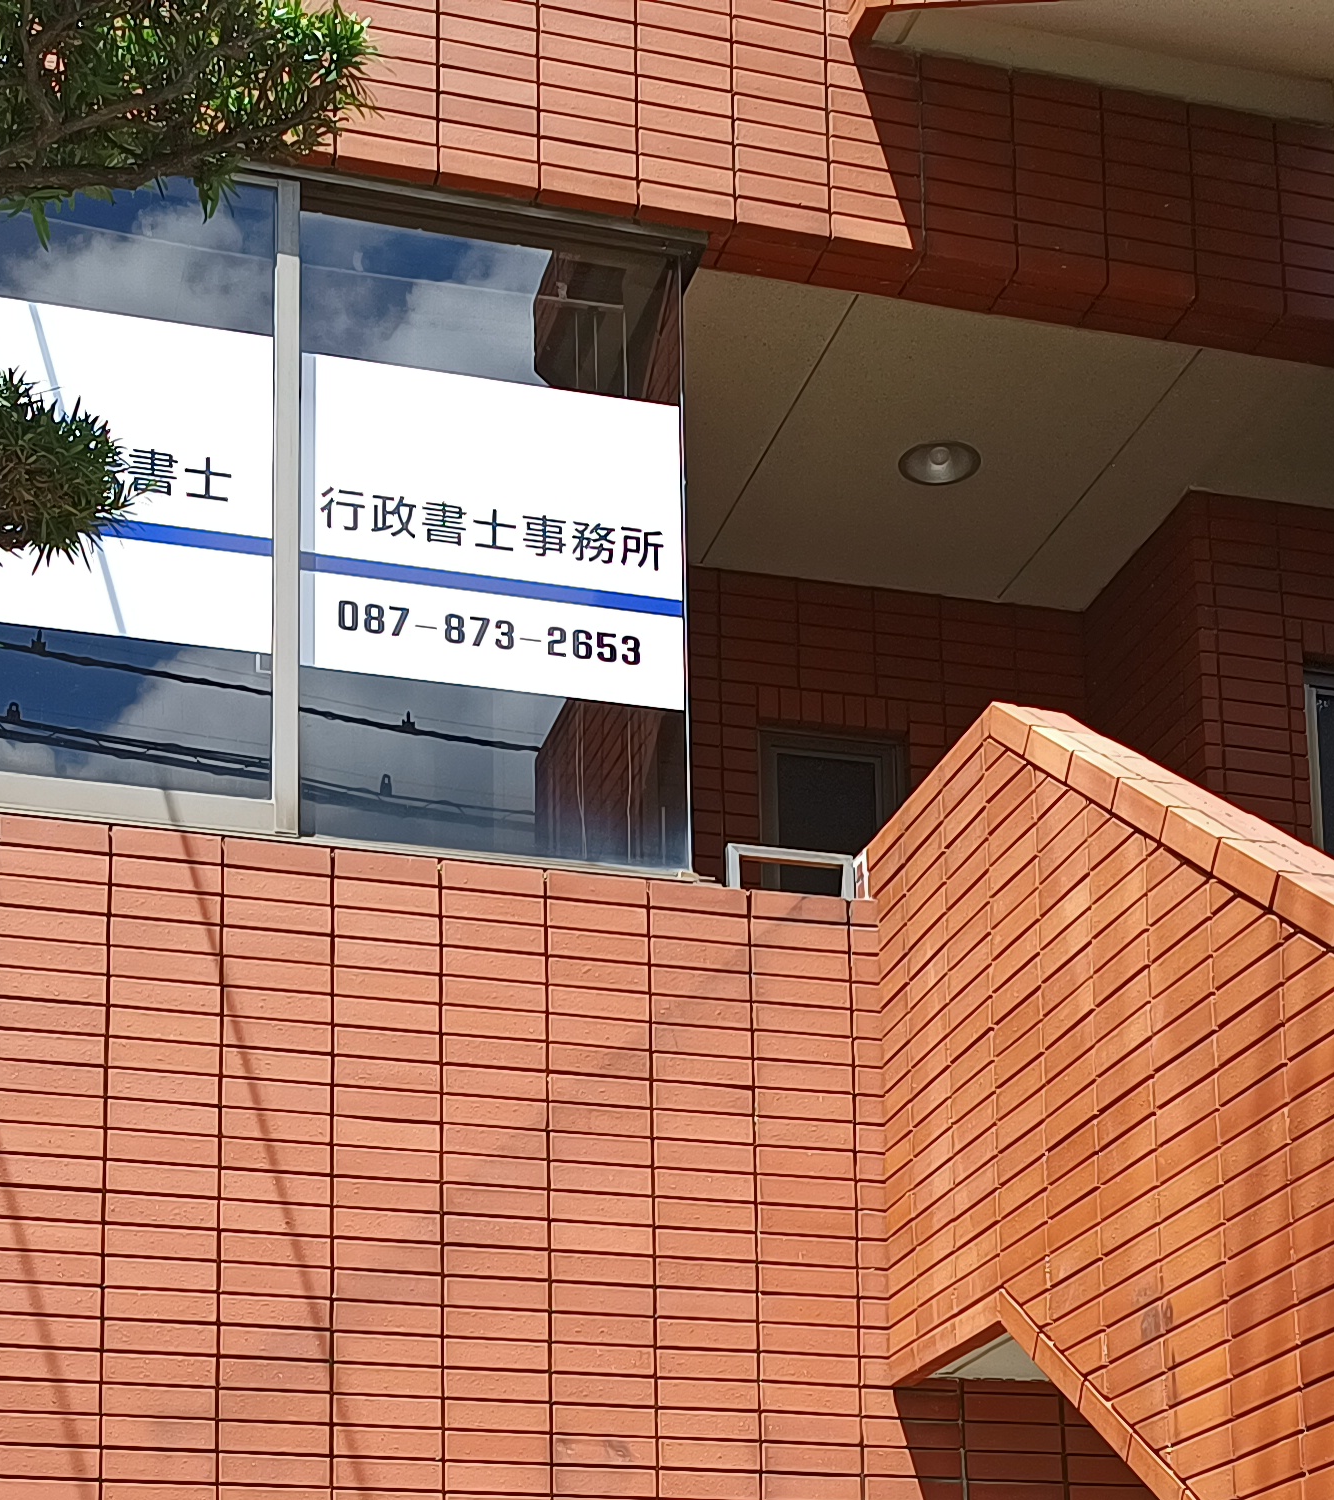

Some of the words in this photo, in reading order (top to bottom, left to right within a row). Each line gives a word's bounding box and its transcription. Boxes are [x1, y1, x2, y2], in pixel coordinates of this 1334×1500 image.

[319, 486, 665, 572] 行政書士事務所
[337, 600, 642, 666] 087-873-2653
